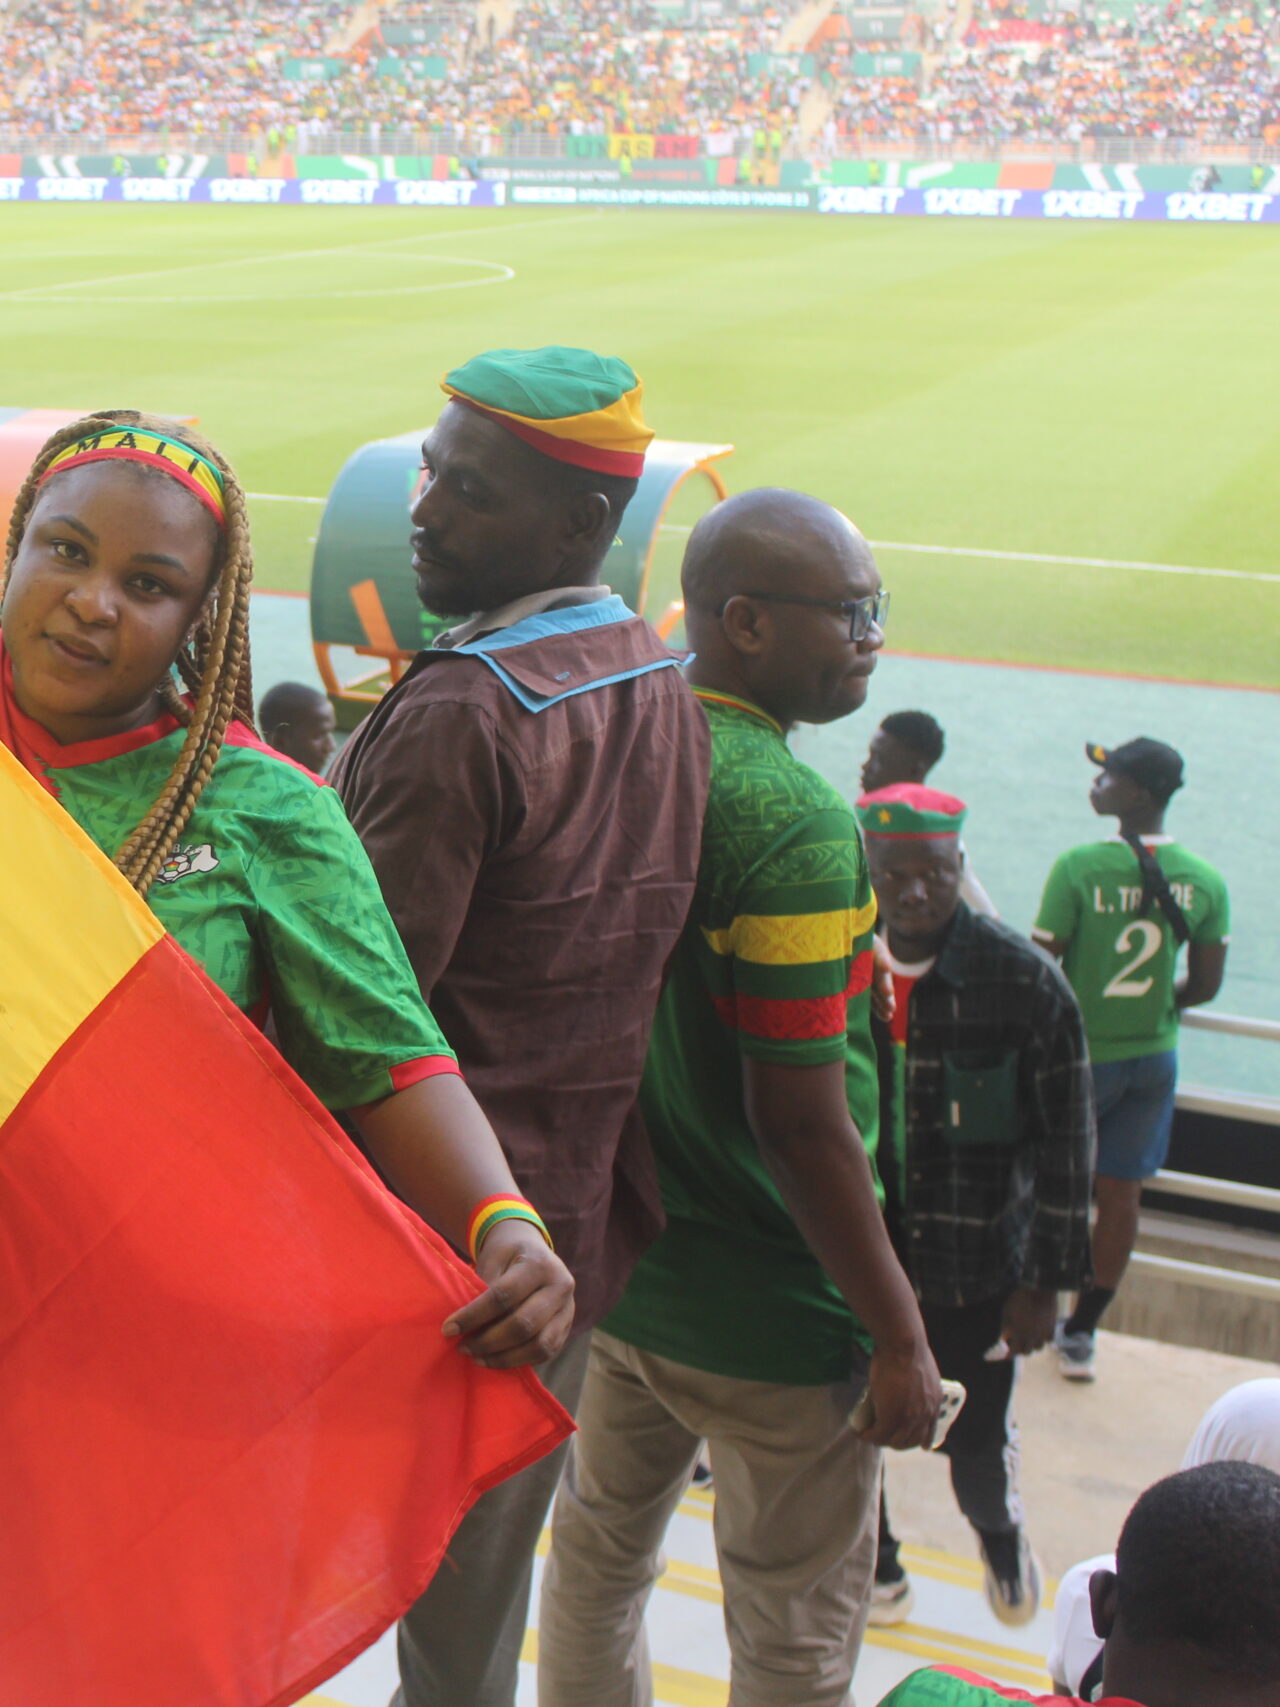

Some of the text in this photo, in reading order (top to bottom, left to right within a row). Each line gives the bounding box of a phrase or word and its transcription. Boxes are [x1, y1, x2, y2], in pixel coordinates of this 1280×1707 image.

[923, 187, 1022, 216] 1XBET
[1042, 190, 1145, 218] 1XBET
[1165, 192, 1273, 221] 1XBET
[74, 432, 200, 475] MALI
[1102, 919, 1162, 998] 2
